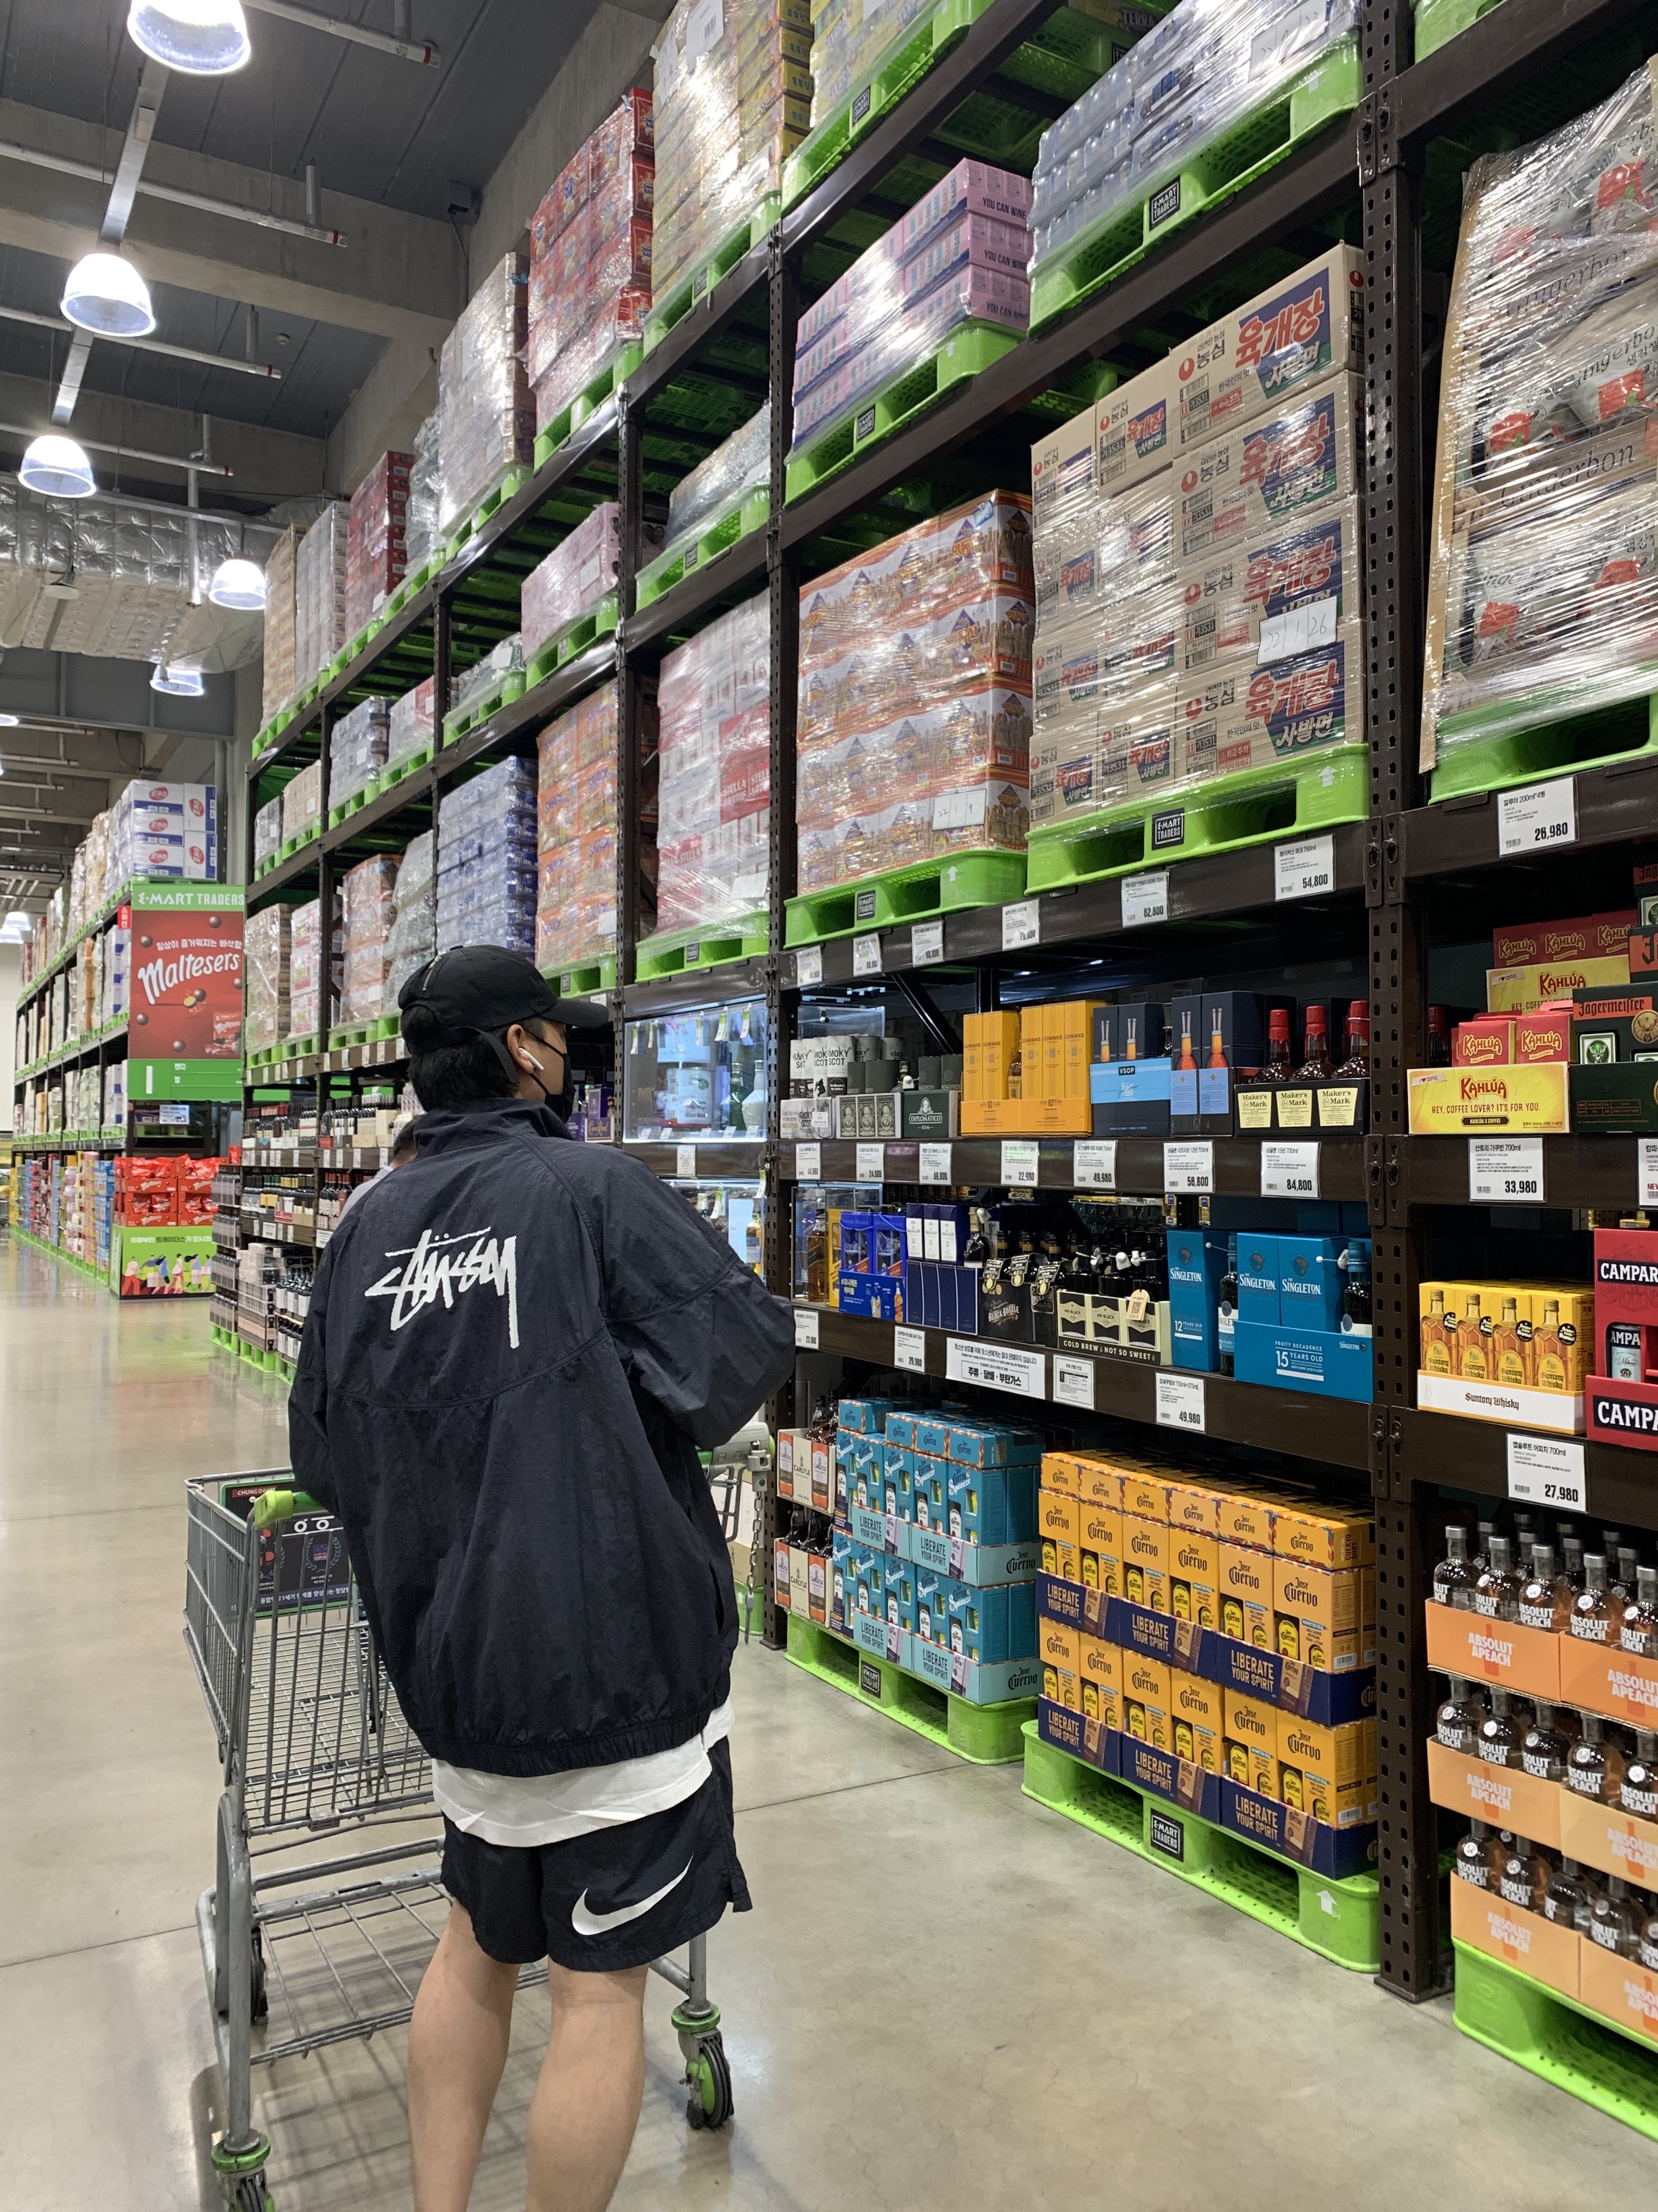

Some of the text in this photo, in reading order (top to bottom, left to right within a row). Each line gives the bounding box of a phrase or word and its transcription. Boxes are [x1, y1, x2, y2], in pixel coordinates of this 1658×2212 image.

[983, 197, 1026, 219] YOU CAN WINE
[984, 250, 1027, 270] YOU CAN WINE
[986, 302, 1012, 318] YOU CAN
[1235, 286, 1325, 369] 육개장
[1197, 340, 1225, 369] 농심
[1243, 369, 1250, 380] 맛
[1126, 407, 1165, 445] 육개장
[1200, 455, 1229, 483] 농심
[1267, 630, 1282, 650] 22
[1310, 615, 1327, 636] 26
[1205, 687, 1234, 712] 농심
[1244, 659, 1340, 724] 육개장
[1227, 720, 1260, 738] 한국인의 맛
[1275, 712, 1333, 748] 사발면
[1129, 738, 1169, 767] 육개장
[1196, 734, 1216, 752] 가3531
[1141, 763, 1165, 778] 사발면
[723, 778, 747, 797] STELLA
[1158, 826, 1180, 839] TRADERS
[1535, 822, 1567, 841] 26,980
[1302, 873, 1328, 889] 54,800
[197, 893, 244, 906] TRADERS
[138, 952, 240, 1005] Maltesers
[1512, 1003, 1524, 1011] HEY,
[1460, 1076, 1508, 1101] KAHLÚA
[1432, 1105, 1445, 1114] HEY,
[1447, 1104, 1468, 1113] COFFEE
[1471, 1104, 1495, 1113] LOVER?
[1511, 1103, 1522, 1111] FOR
[1018, 1172, 1035, 1181] 22,980
[1093, 1173, 1112, 1183] 49,980
[1287, 1179, 1312, 1192] 84,800
[1505, 1181, 1537, 1194] 33,980
[1170, 1268, 1202, 1282] SINGLETON
[1239, 1274, 1275, 1290] SINGLETON
[1600, 1262, 1658, 1283] CAMPAR
[1282, 1279, 1321, 1295] SINGLETON
[1175, 1321, 1182, 1331] 12
[1063, 1340, 1080, 1349] COLD
[1081, 1344, 1098, 1352] BREW
[1129, 1351, 1151, 1361] SWEET
[1293, 1343, 1322, 1351] DECADENCE
[1276, 1350, 1289, 1367] 15
[1290, 1352, 1309, 1361] YEARS
[1429, 1357, 1449, 1367] Suntory
[1464, 1362, 1485, 1372] Suntory
[969, 1367, 1022, 1386] 주류 담배 부탄가스
[1465, 1392, 1519, 1411] Suntory Whisky
[1179, 1411, 1200, 1424] 49,980
[1513, 1441, 1566, 1456] 앱솔루트 어피치 700ml
[793, 1464, 811, 1476] CARLYLE
[1545, 1484, 1578, 1502] 27,980
[1053, 1505, 1063, 1516] Jose
[1046, 1513, 1069, 1531] Cuervo
[1096, 1517, 1106, 1527] Jose
[1087, 1524, 1113, 1543] Cuervo
[1140, 1530, 1151, 1542] Jose
[1131, 1538, 1158, 1558] Cuervo
[1178, 1551, 1208, 1572] Cuervo
[790, 1574, 807, 1590] CARLYLE
[278, 1592, 295, 1601] 21세기
[1047, 1583, 1080, 1607] LIBERATE
[1047, 1595, 1080, 1621] YOUR SPIRIT
[1132, 1613, 1169, 1639] LIBERATE
[1132, 1628, 1169, 1653] YOUR SPIRIT
[1468, 1632, 1515, 1656] ABSOLUT
[1231, 1649, 1274, 1680] LIBERATE
[1471, 1645, 1512, 1668] APEACH
[1231, 1666, 1274, 1694] YOUR SPIRIT
[1048, 1709, 1080, 1731] LIBERATE
[1048, 1722, 1080, 1747] YOUR SPIRIT
[1467, 1774, 1513, 1798] ABSOLUT
[1470, 1787, 1511, 1811] APEACH
[1153, 1829, 1179, 1848] TRADERS
[1611, 1842, 1657, 1871] APEACH
[1487, 1911, 1532, 1941] ABSOLUT
[1490, 1925, 1530, 1955] APEACH
